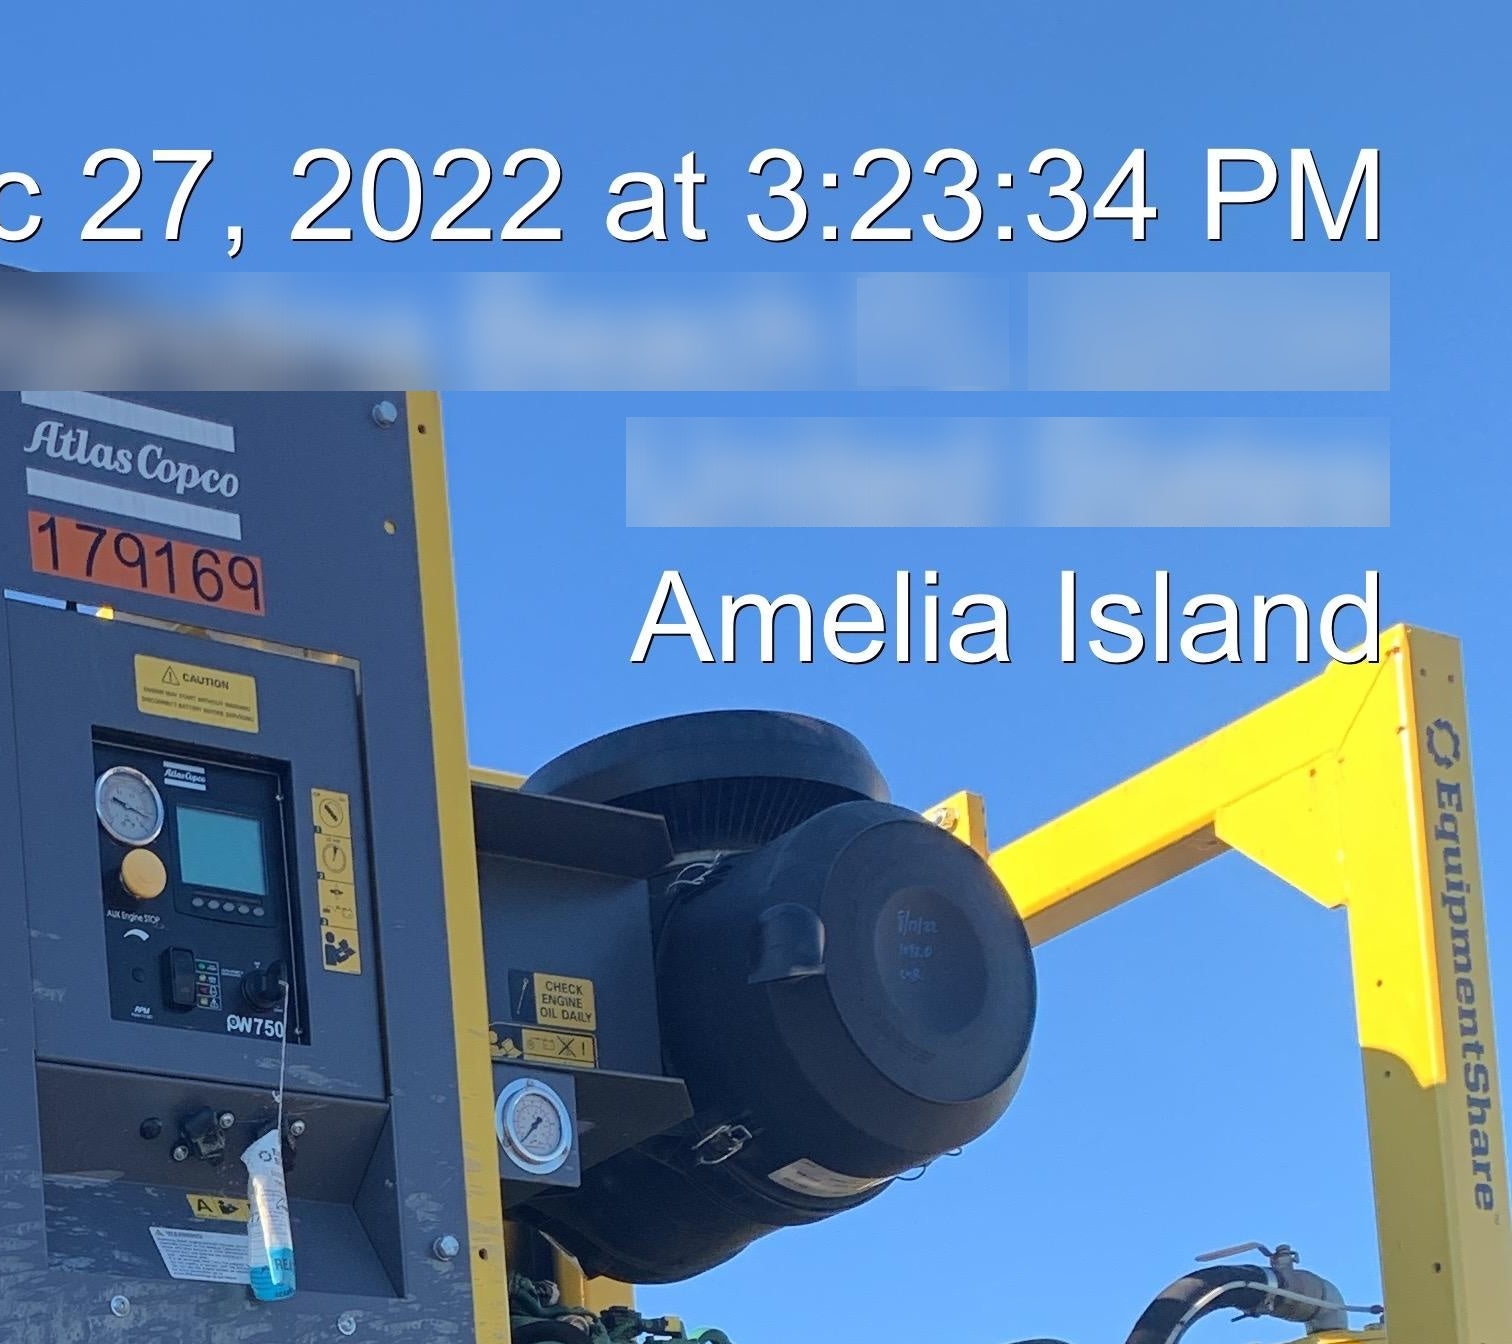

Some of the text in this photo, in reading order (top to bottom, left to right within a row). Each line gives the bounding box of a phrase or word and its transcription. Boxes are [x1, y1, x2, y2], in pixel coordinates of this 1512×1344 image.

[23, 419, 239, 498] Atlas Copco
[36, 516, 261, 611] 179169
[182, 673, 229, 690] CAUTION
[121, 910, 143, 924] Engine
[545, 980, 584, 996] CHECK
[1434, 780, 1494, 1212] EquipmentShare
[541, 994, 584, 1009] ENGINE
[539, 1006, 593, 1024] OIL DAILY
